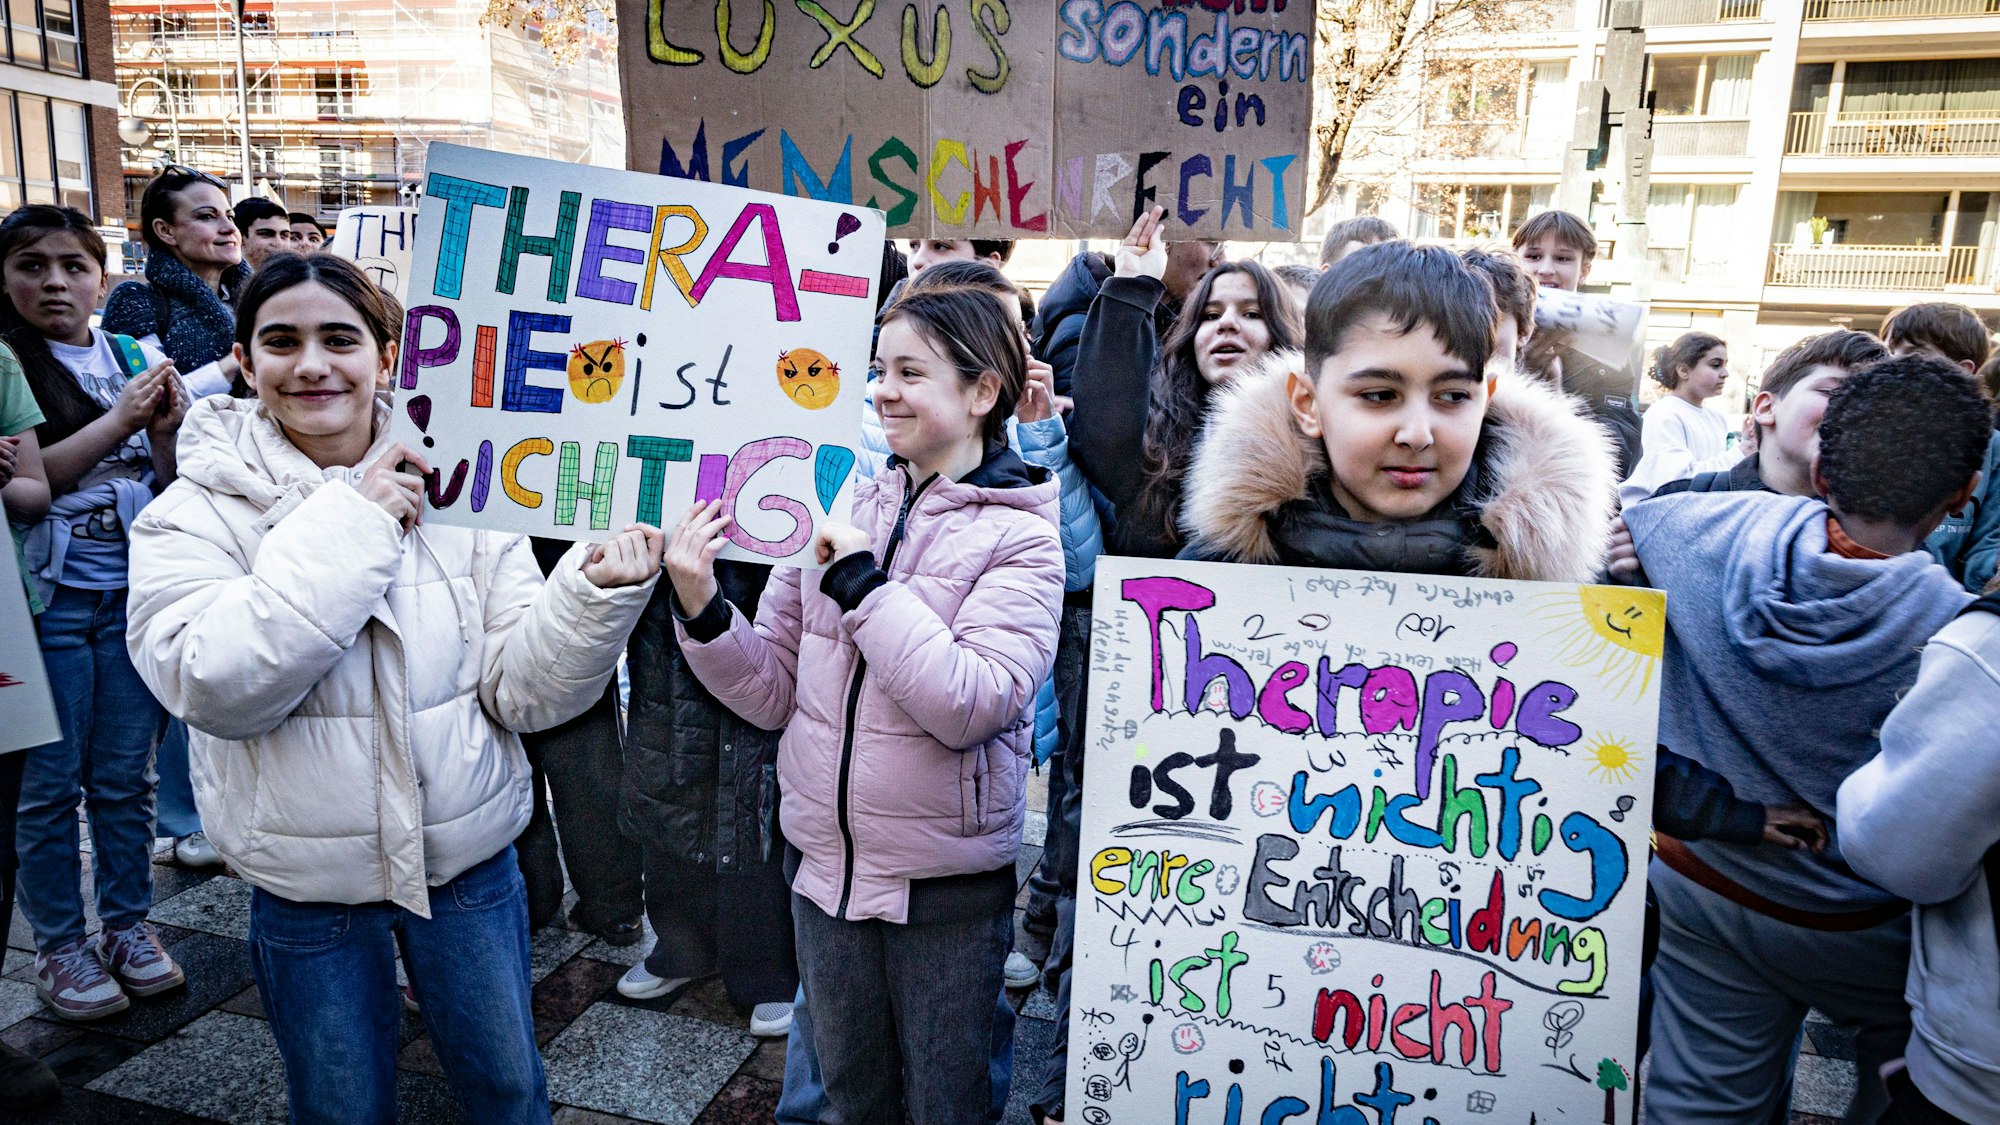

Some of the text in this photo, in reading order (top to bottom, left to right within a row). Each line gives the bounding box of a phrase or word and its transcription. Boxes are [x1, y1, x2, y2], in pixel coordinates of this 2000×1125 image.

[645, 0, 1011, 95] LUXUS
[1177, 79, 1266, 132] ein
[400, 304, 733, 416] PIE ist
[1121, 577, 1582, 798] Therapie
[1129, 727, 1260, 820] ist
[1149, 930, 1250, 1019] ist
[1313, 969, 1514, 1073] nicht
[1175, 1055, 1441, 1125] richt
